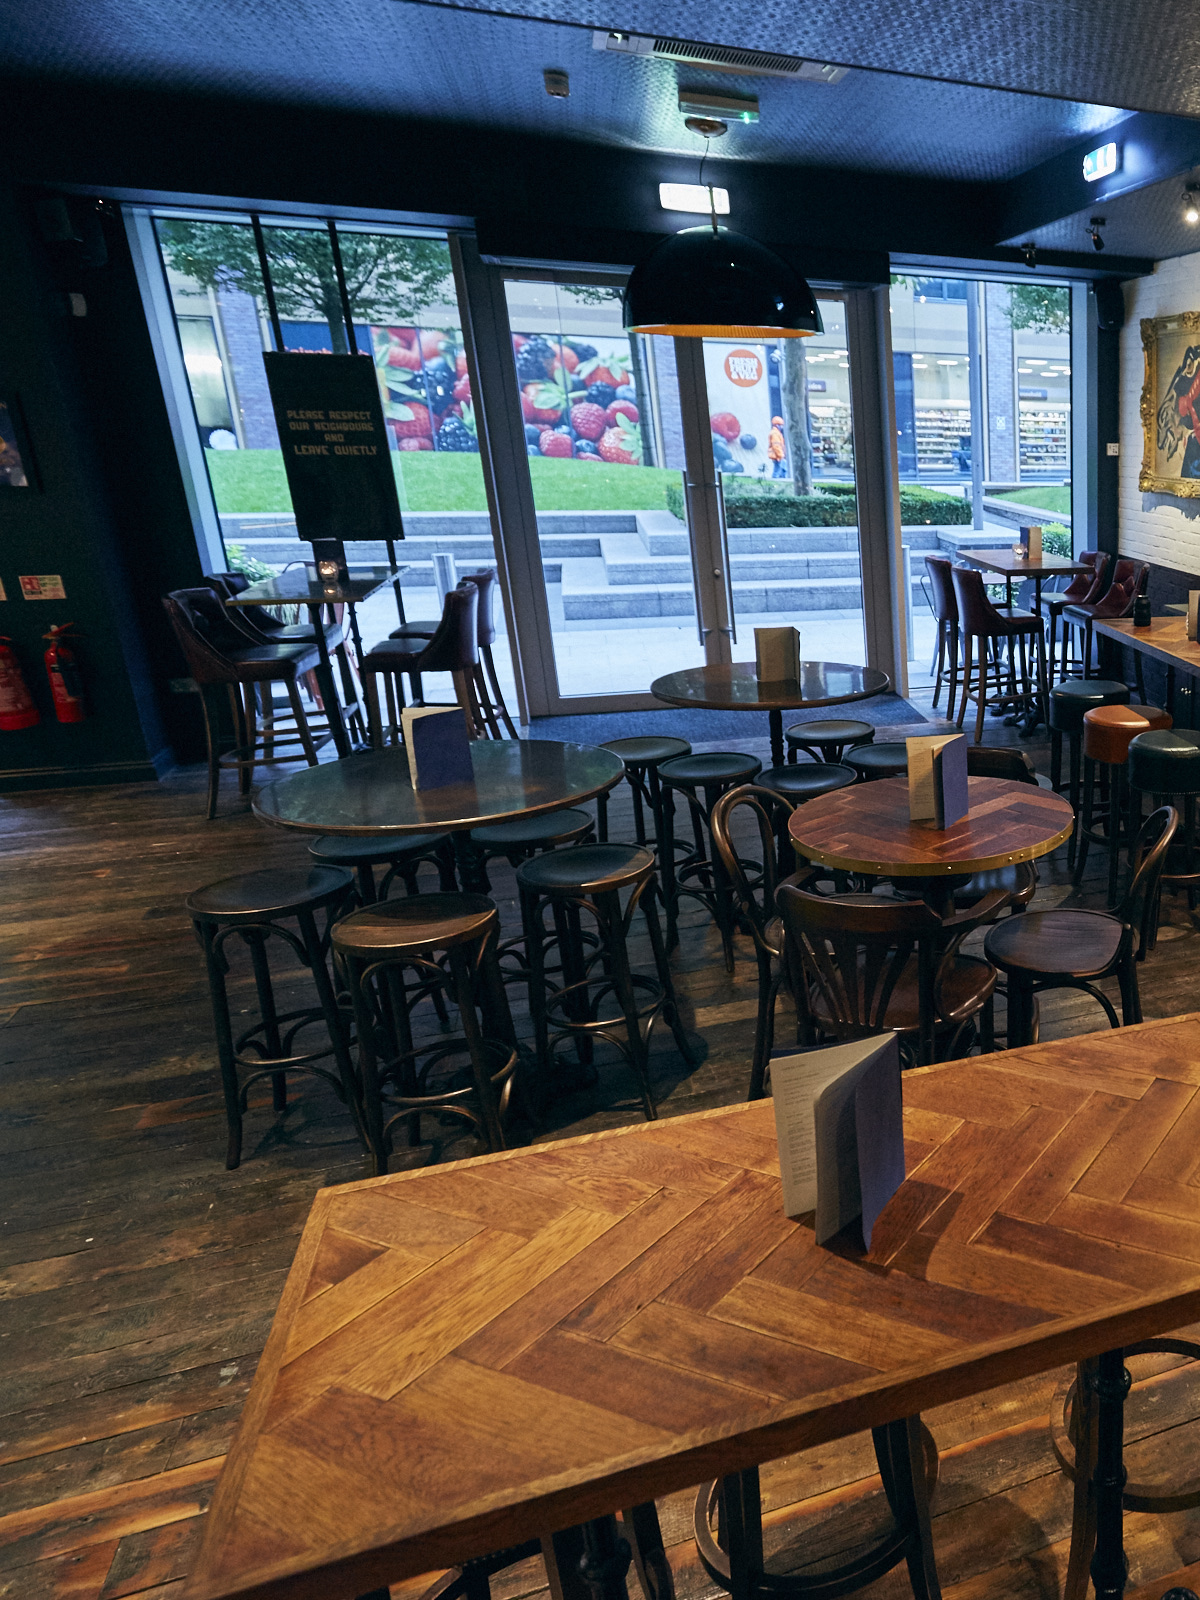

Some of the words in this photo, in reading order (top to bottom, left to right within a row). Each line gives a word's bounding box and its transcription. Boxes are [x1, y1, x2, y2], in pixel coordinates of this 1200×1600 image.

[728, 356, 758, 367] FRESH
[730, 364, 758, 373] FRUIT
[286, 410, 324, 419] PLEASE
[329, 410, 371, 420] RESPECT
[289, 421, 309, 431] OUR
[314, 422, 374, 431] NEIGHBOURS
[324, 433, 345, 442] AND
[294, 445, 330, 455] LEAVE
[334, 445, 377, 455] QUIETLY
